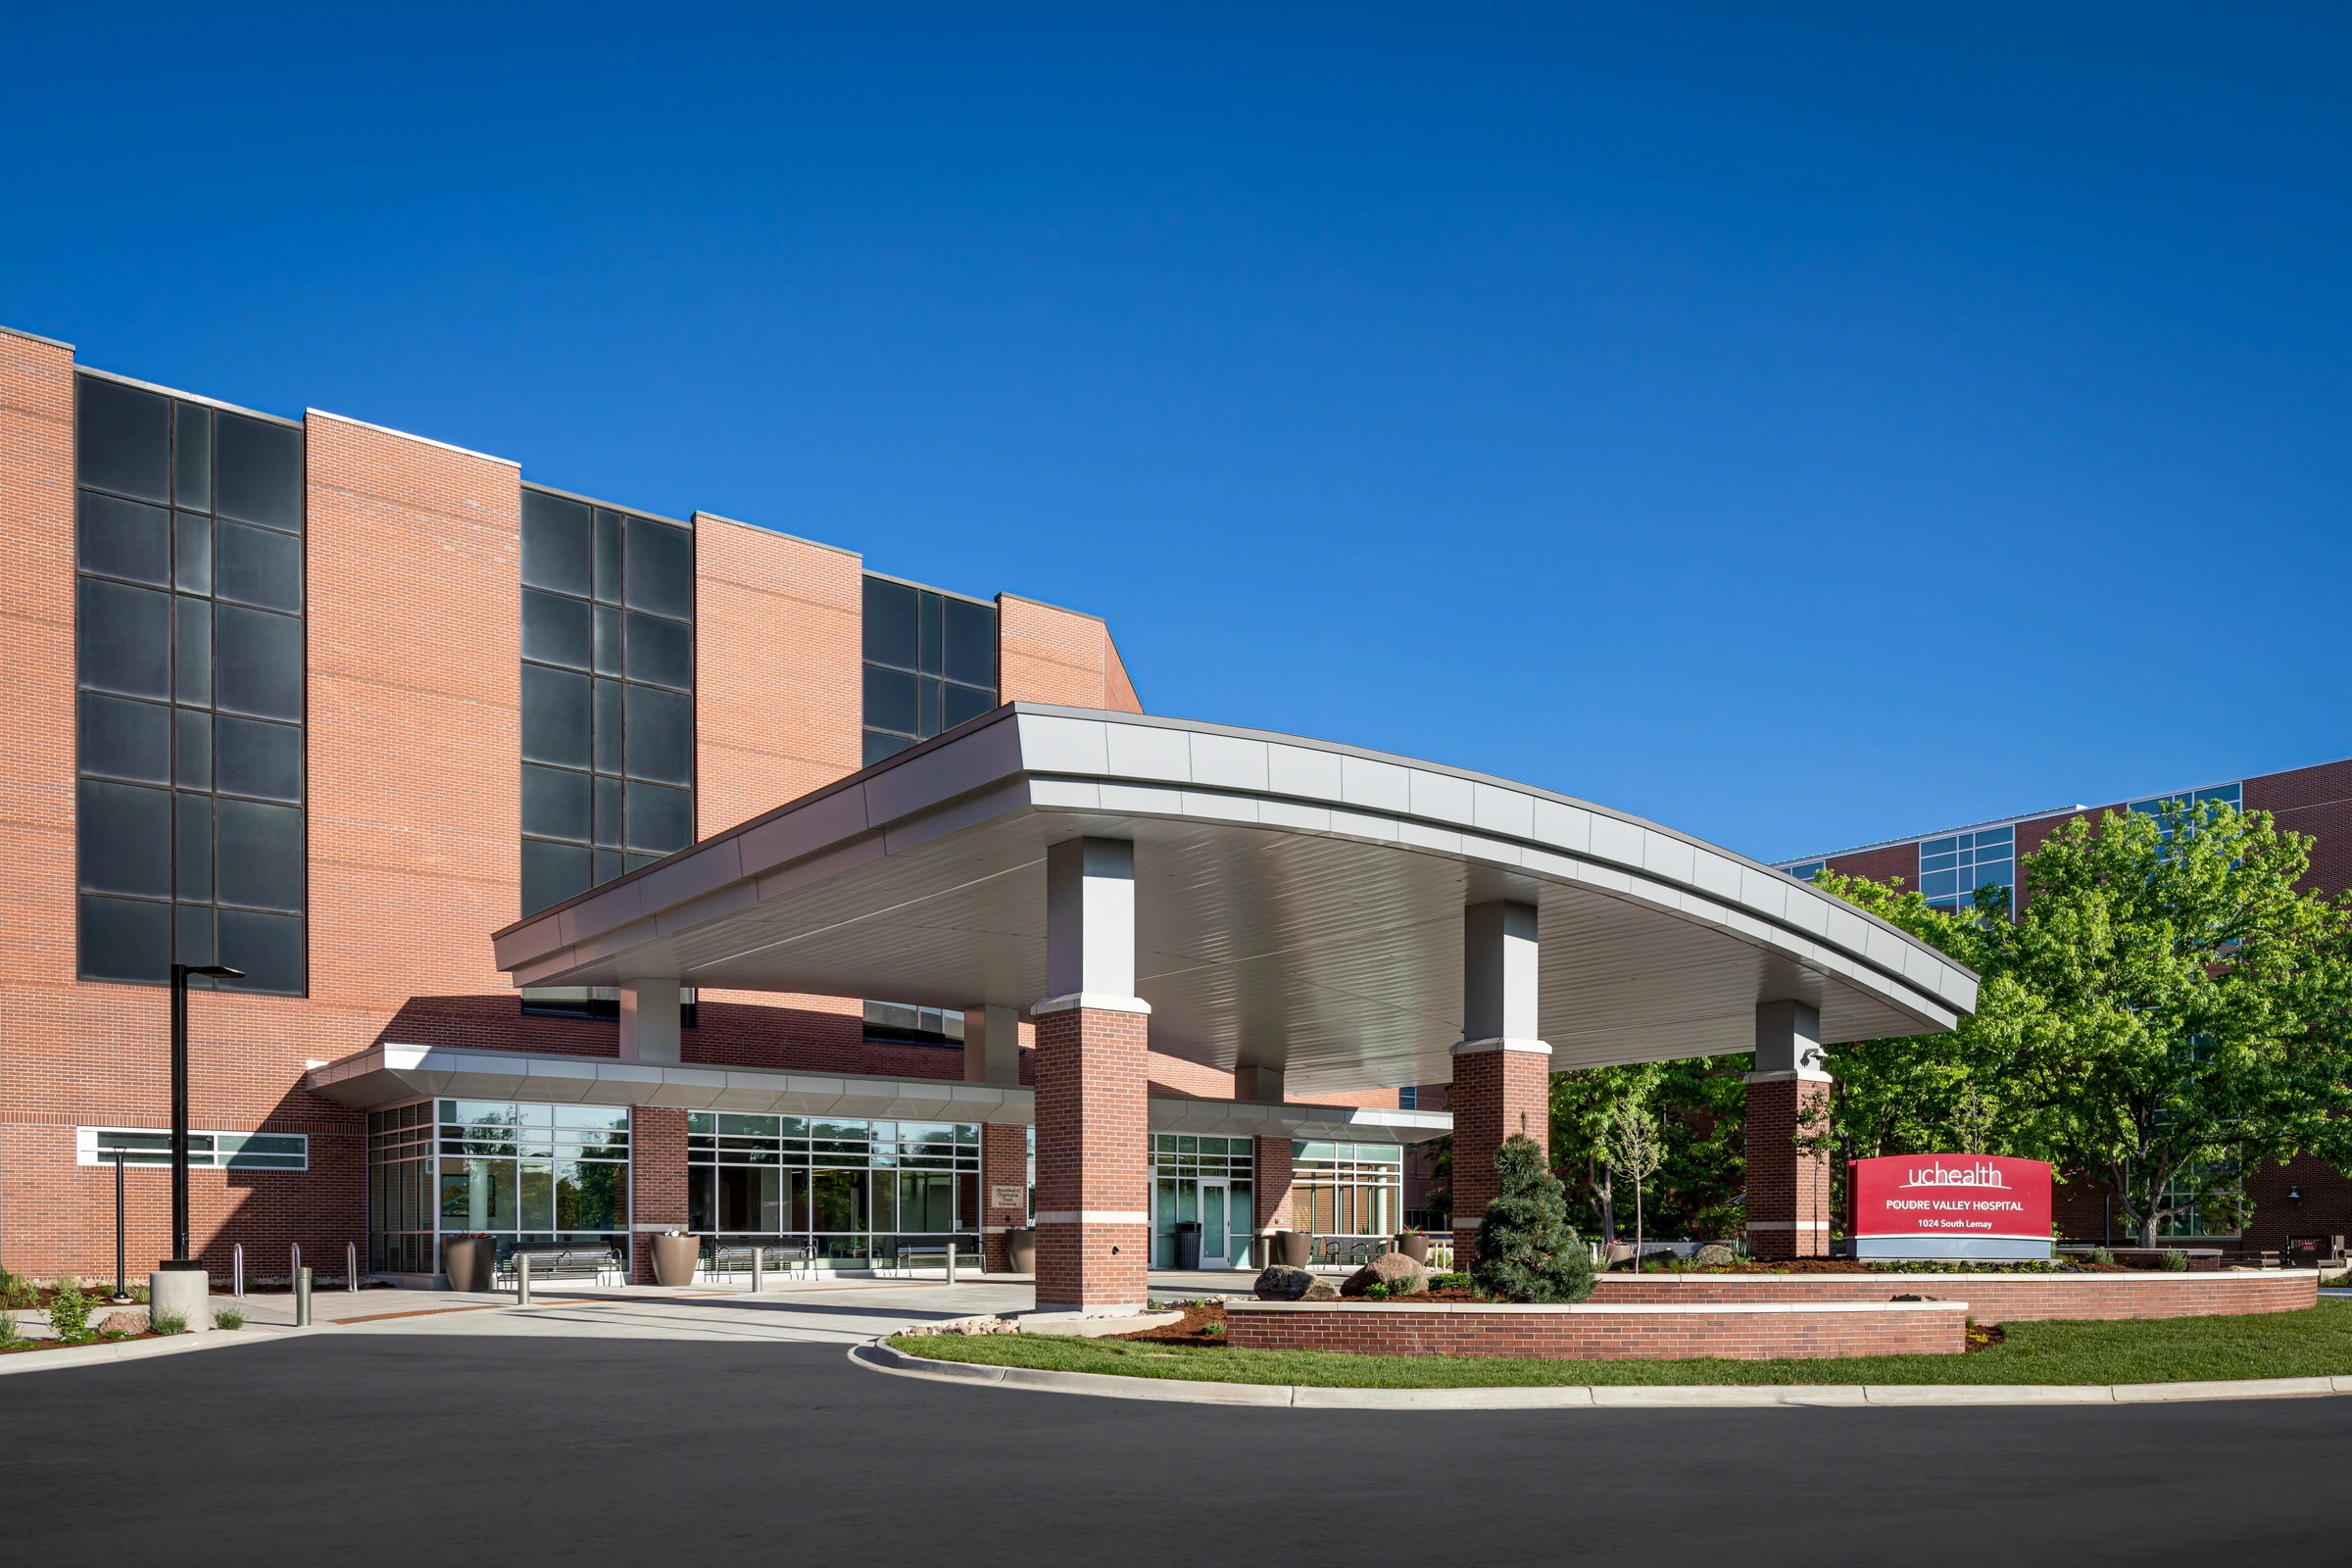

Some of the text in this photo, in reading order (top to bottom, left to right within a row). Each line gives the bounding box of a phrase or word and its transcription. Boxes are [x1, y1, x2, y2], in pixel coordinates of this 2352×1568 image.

[1908, 1160, 2002, 1186] uchealth
[1886, 1200, 2024, 1211] POUDRE VALLEY HOSPITAL
[1918, 1219, 1992, 1230] 1024 South Lemay
